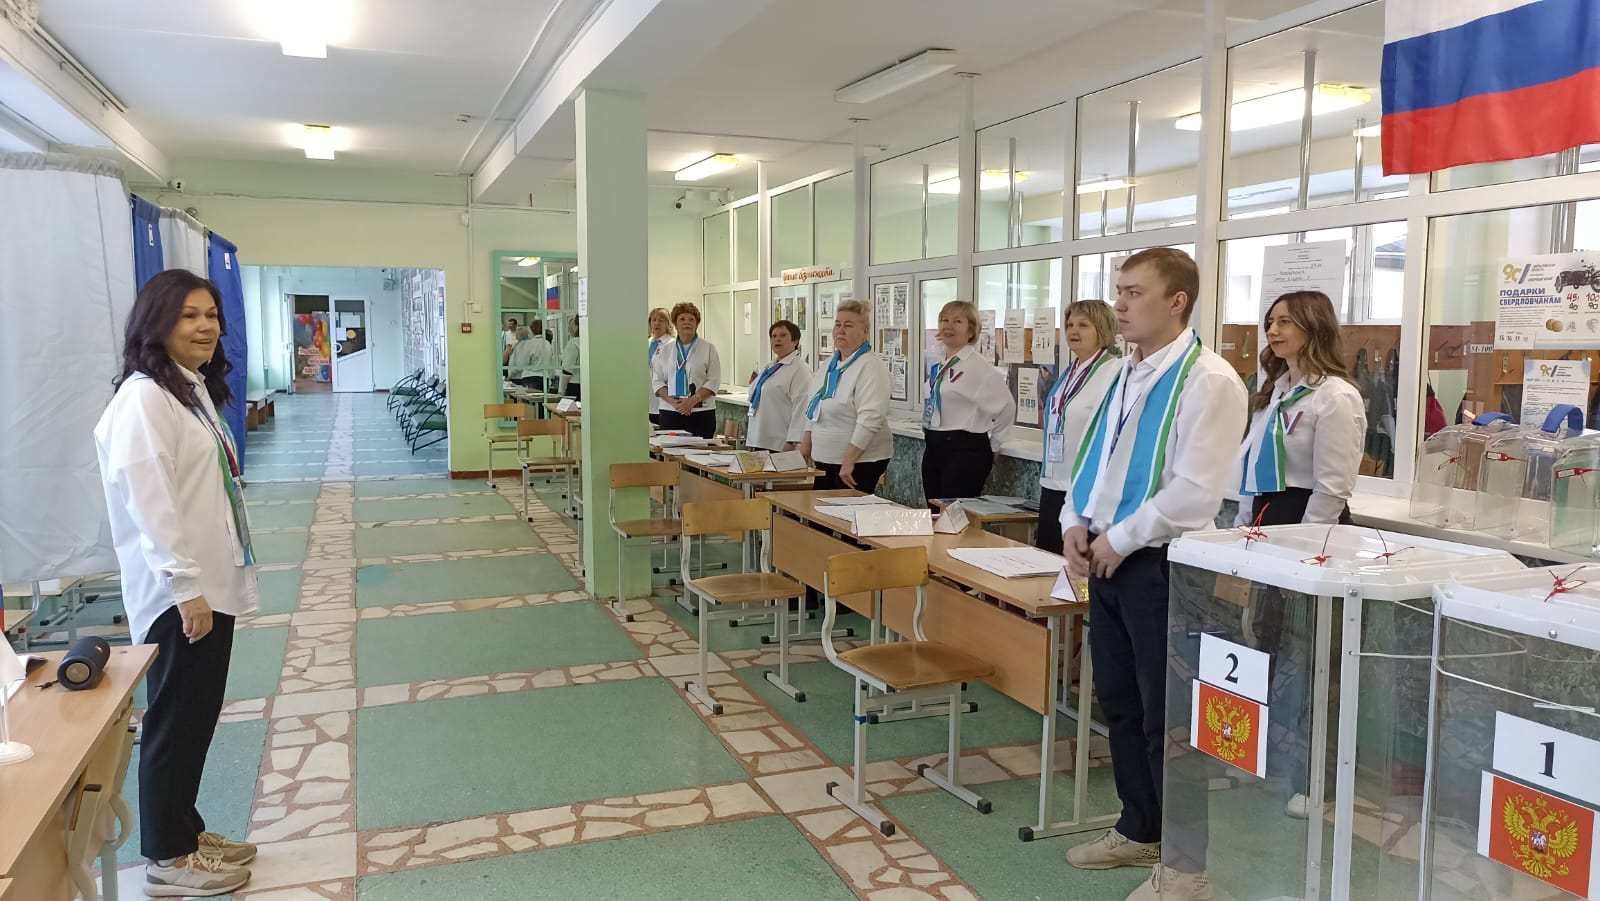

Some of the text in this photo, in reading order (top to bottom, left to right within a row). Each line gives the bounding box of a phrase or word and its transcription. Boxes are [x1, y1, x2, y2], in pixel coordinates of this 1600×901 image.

[1500, 288, 1545, 297] ПОДАРКИ
[1500, 297, 1561, 306] СВЕРДЛОВЧАНАМ
[1225, 652, 1239, 684] 2
[1539, 741, 1557, 779] 1
